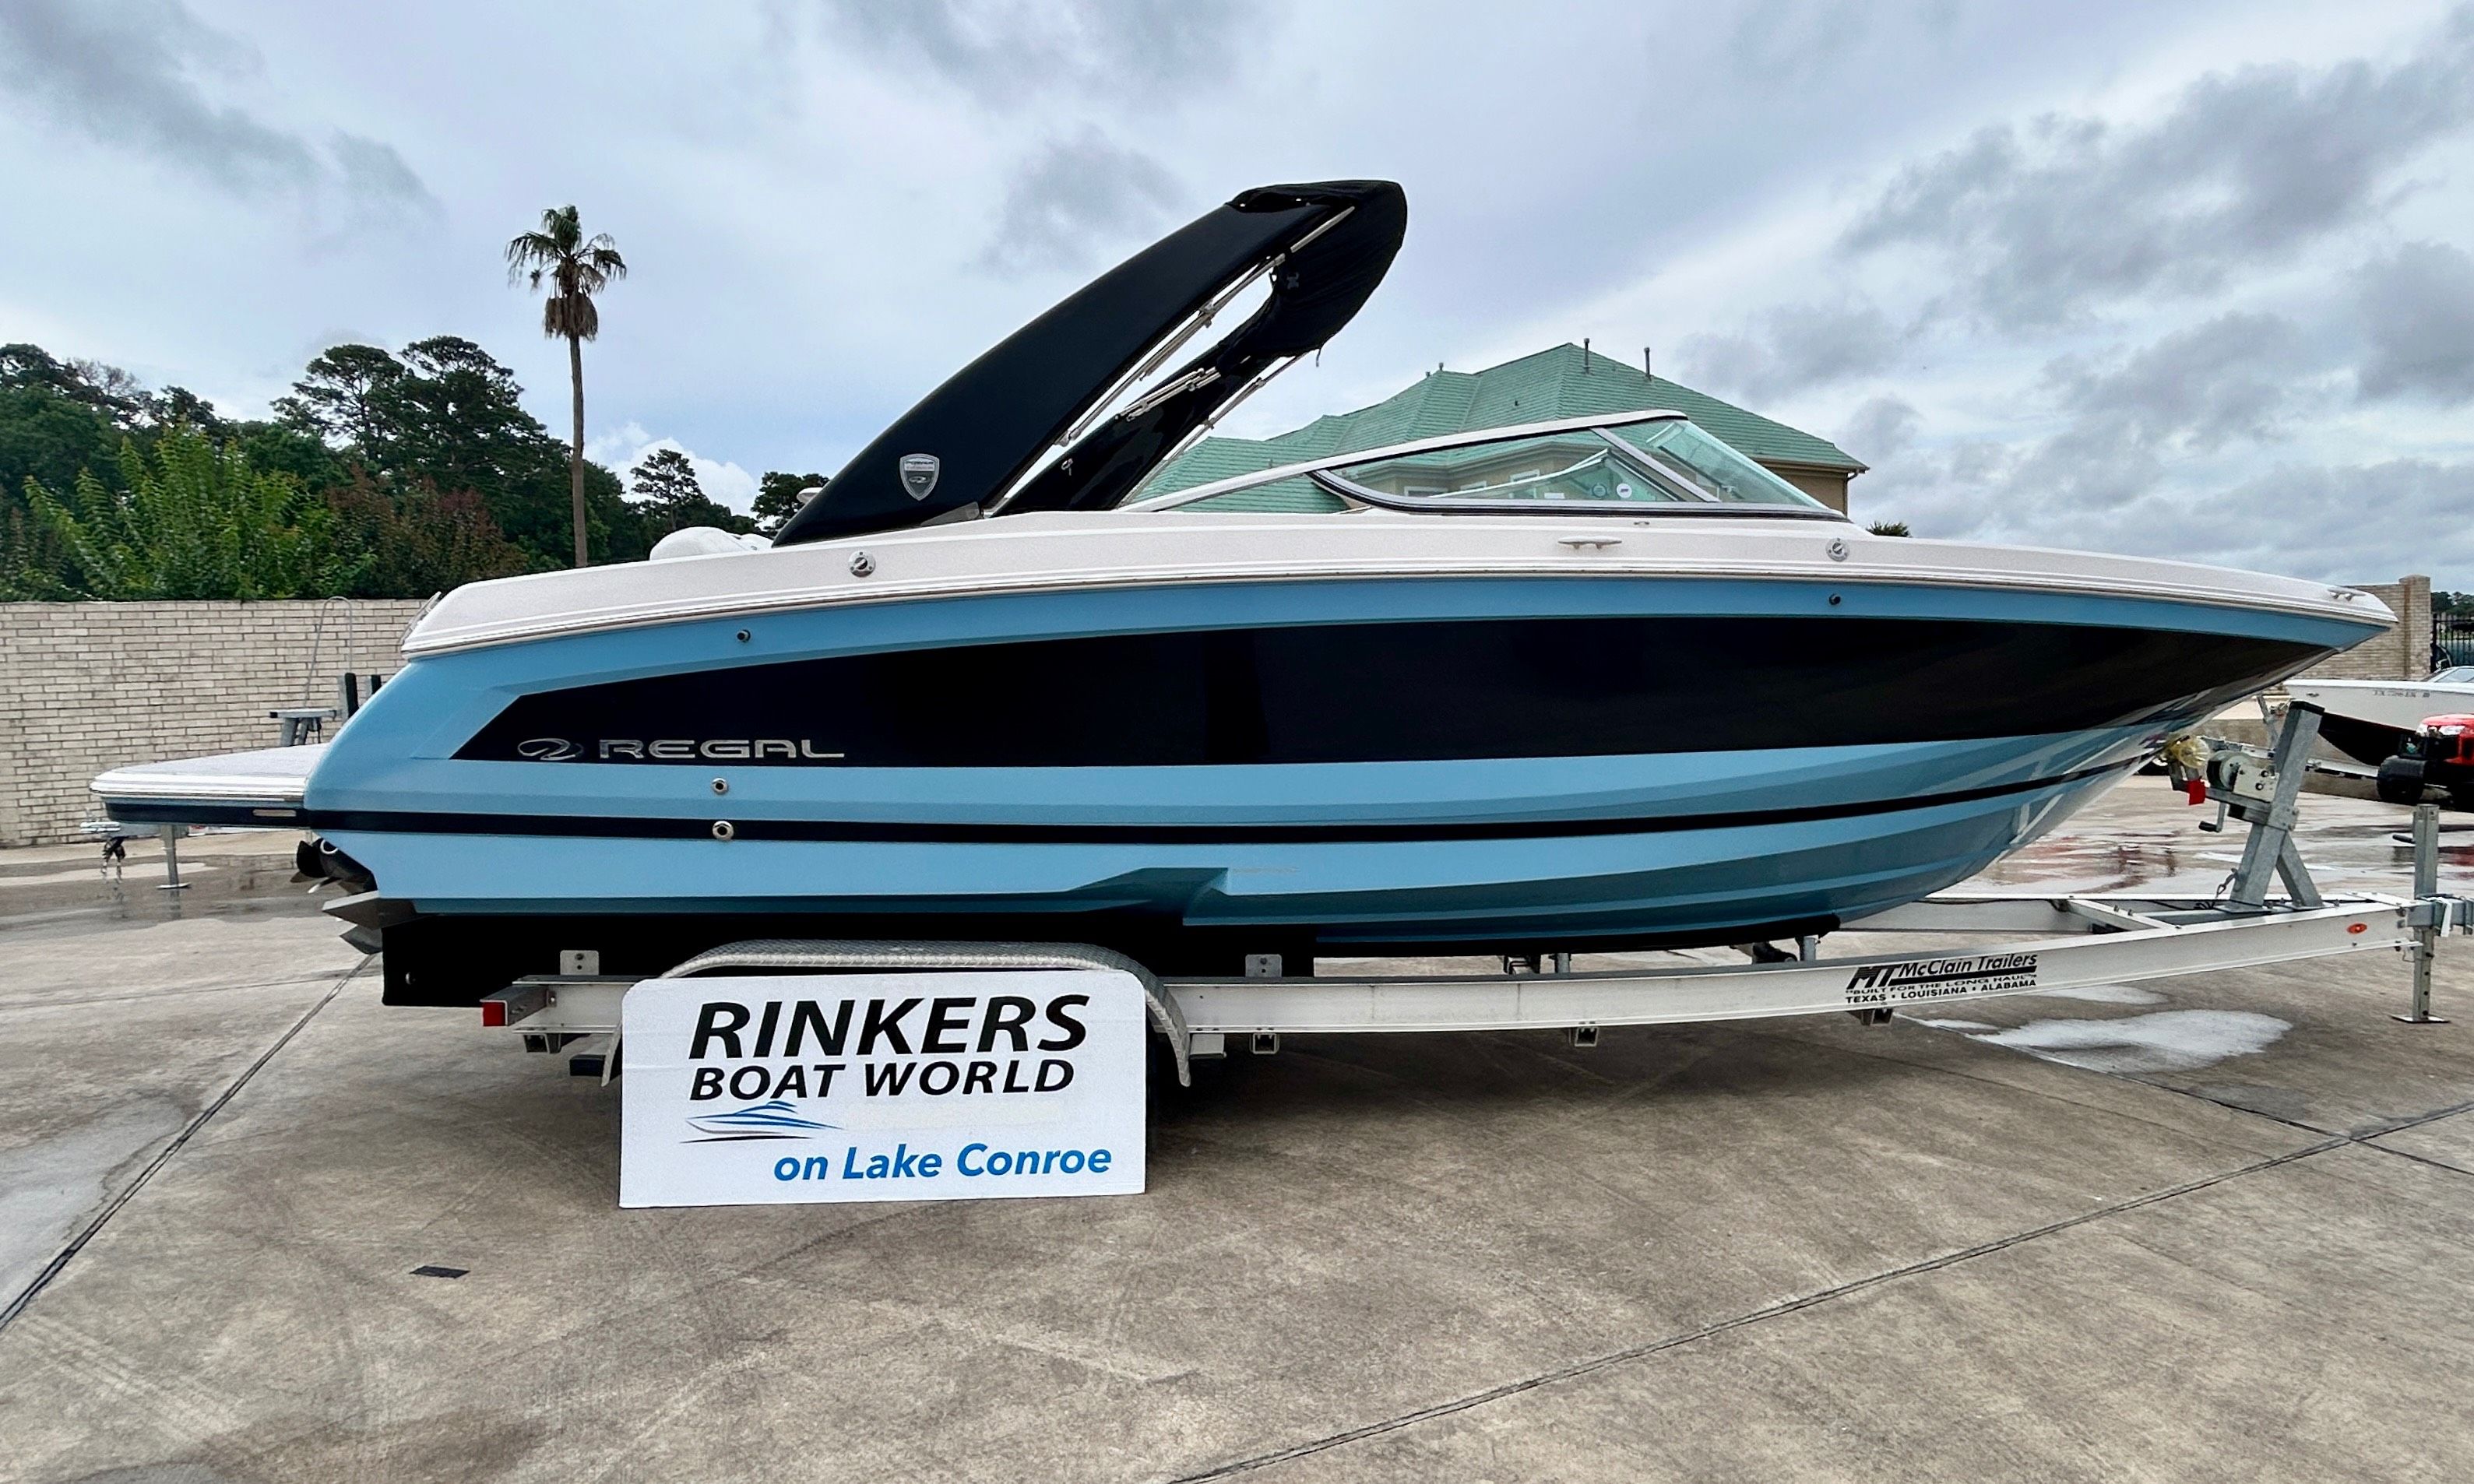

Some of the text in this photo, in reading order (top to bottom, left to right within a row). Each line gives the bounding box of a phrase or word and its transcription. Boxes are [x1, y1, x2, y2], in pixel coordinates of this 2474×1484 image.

[599, 739, 846, 759] REGAL
[1899, 958, 1973, 977] McClain
[1977, 953, 2037, 971] Trailers
[1846, 979, 2036, 1004] TEXAS LOUISIANA ALABAMA
[689, 995, 1090, 1059] RINKERS
[690, 1059, 1075, 1101] BOAT WORLD
[774, 1143, 1112, 1181] on Lake Conroe
